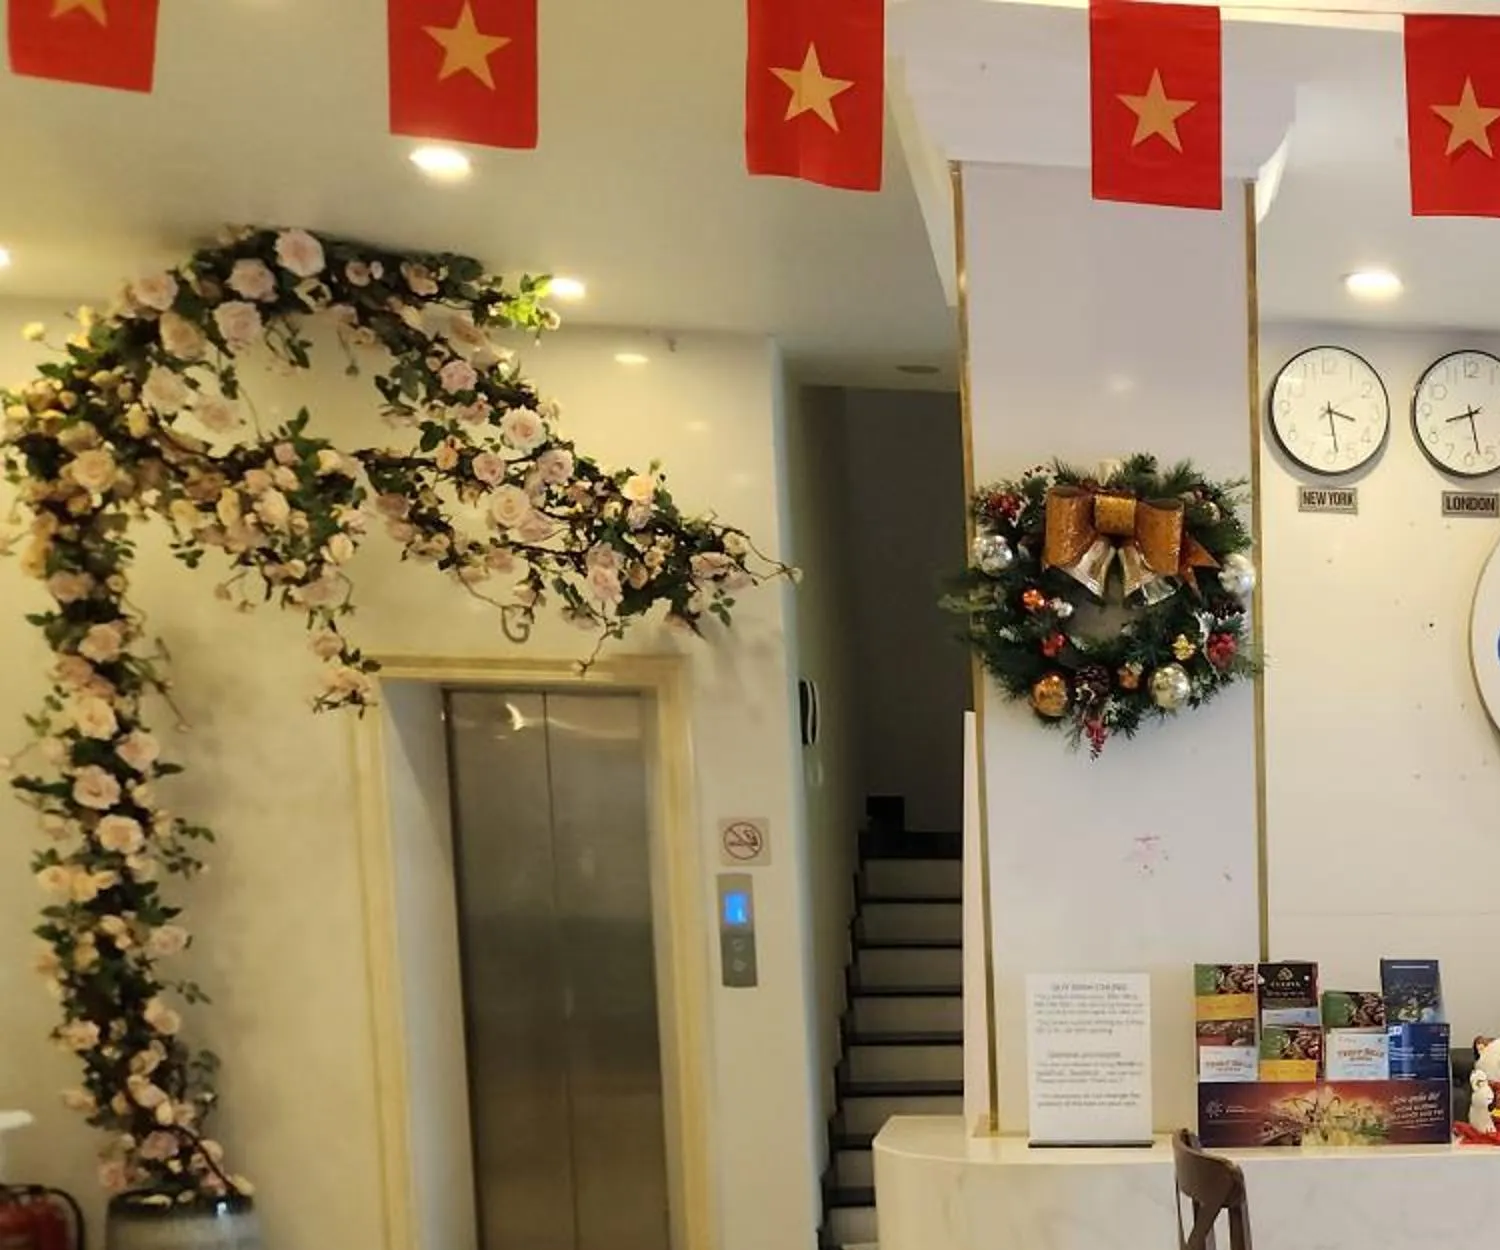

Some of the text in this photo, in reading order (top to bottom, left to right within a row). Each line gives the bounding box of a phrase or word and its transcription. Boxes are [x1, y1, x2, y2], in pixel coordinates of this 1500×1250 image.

[1303, 491, 1353, 506] NEW YORK
[1446, 495, 1496, 512] LONDON
